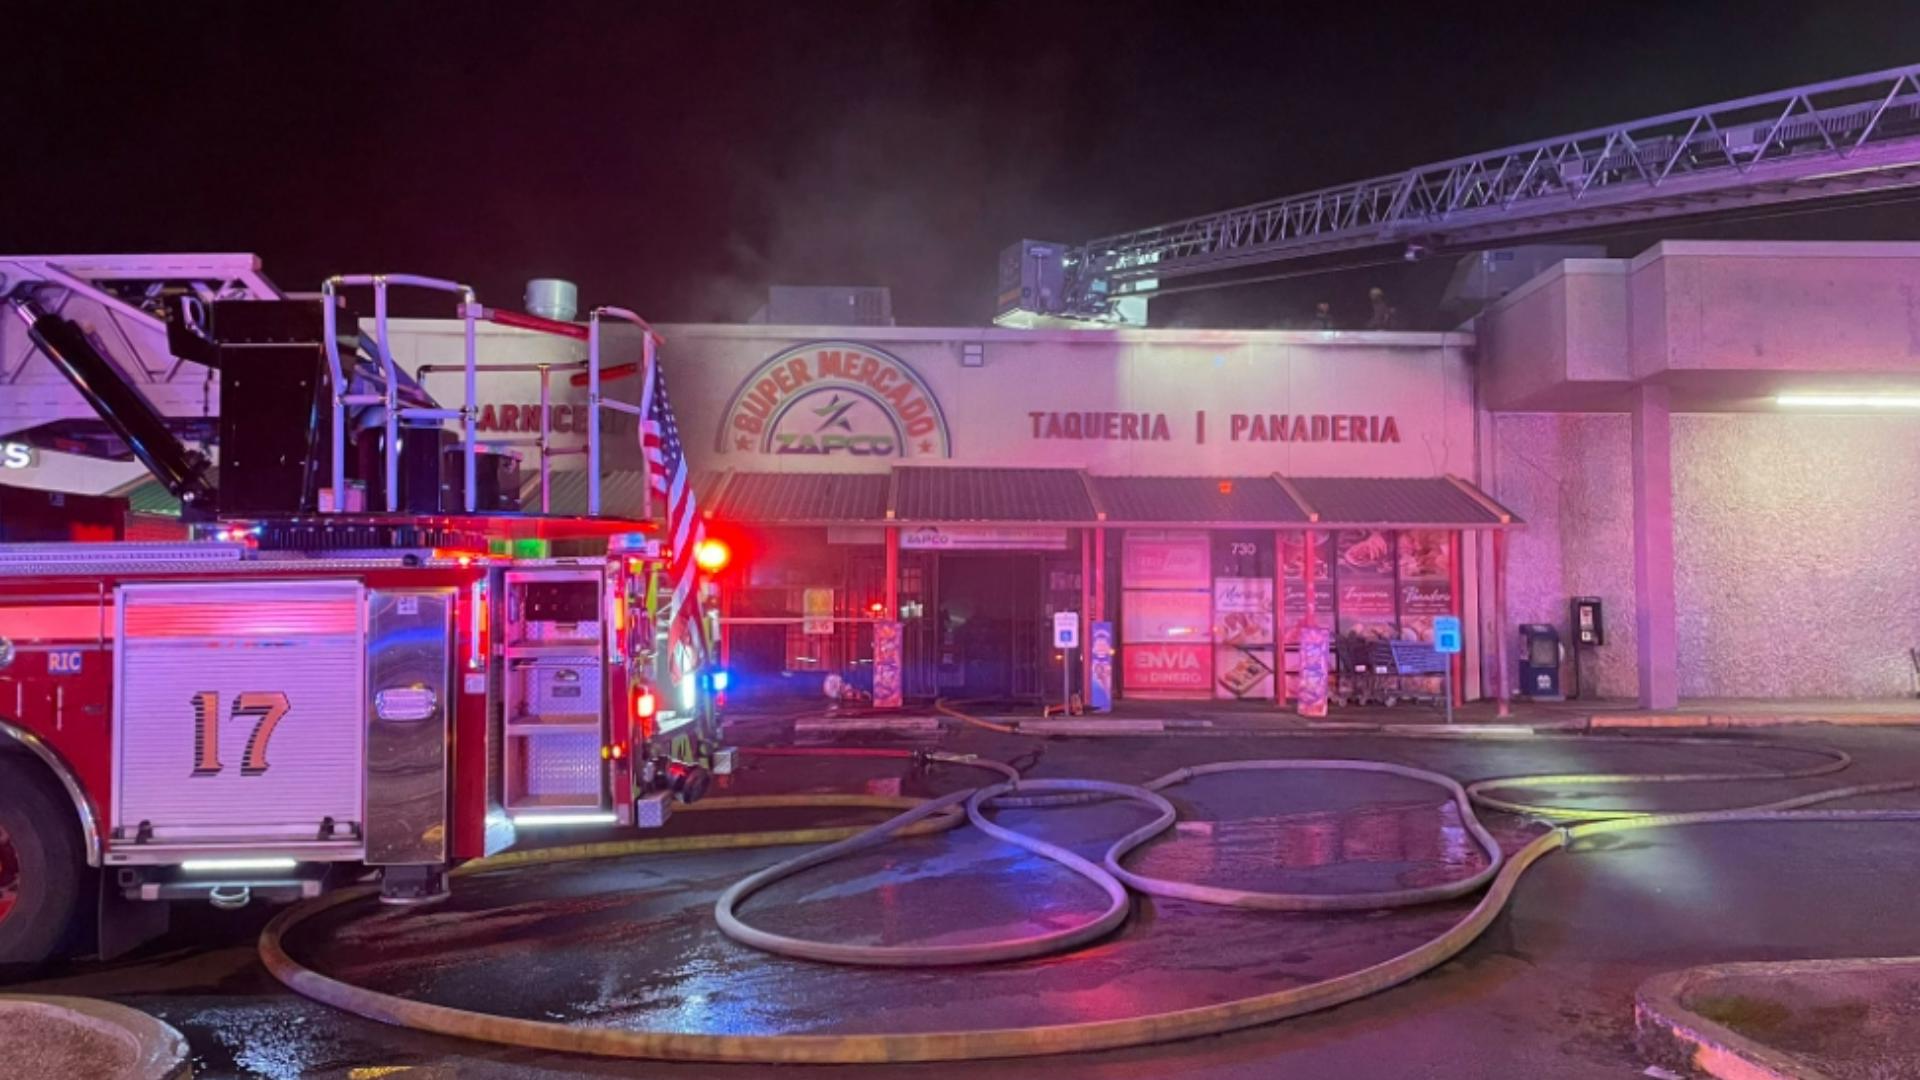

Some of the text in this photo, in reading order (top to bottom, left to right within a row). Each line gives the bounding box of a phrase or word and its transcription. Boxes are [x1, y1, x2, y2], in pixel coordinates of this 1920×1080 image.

[818, 351, 935, 438] MERCADO
[1028, 411, 1171, 441] TAQUERIA
[1229, 413, 1401, 443] PANADERIA
[775, 434, 895, 456] ZAPCO
[1230, 543, 1257, 556] 730
[49, 652, 82, 671] RIC
[190, 691, 291, 777] 17
